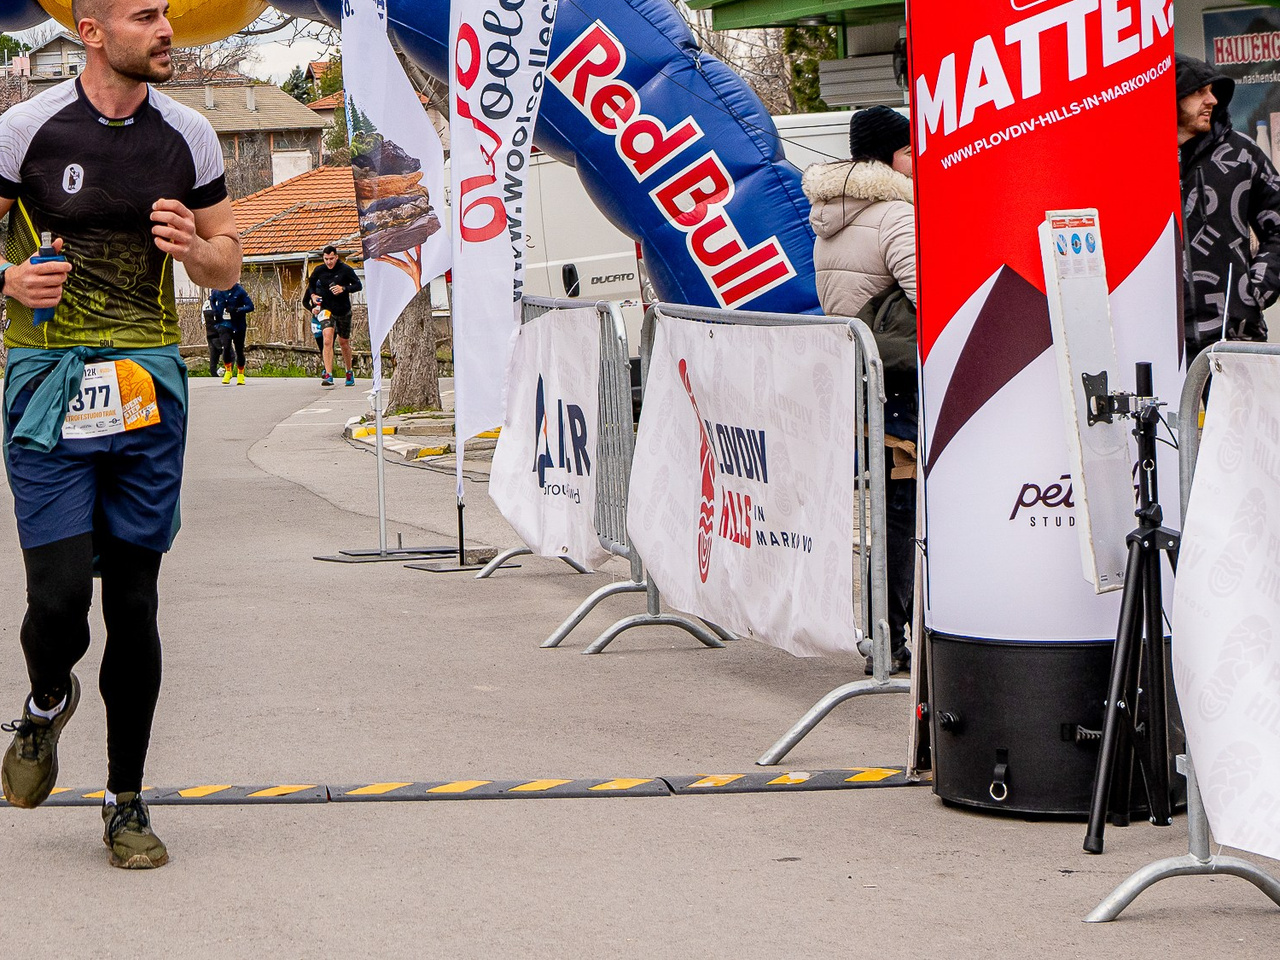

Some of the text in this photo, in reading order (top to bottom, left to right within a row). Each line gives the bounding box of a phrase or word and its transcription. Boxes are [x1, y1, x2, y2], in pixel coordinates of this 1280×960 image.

[940, 54, 1173, 171] WWW.PLOVDIV-HILLS-IN-MARKOVO.COM
[548, 23, 793, 309] Red Bull
[590, 272, 635, 285] DUCATO
[67, 384, 111, 413] 377
[718, 485, 751, 549] HILLS
[753, 504, 766, 522] IN
[755, 529, 813, 554] MARKOVO
